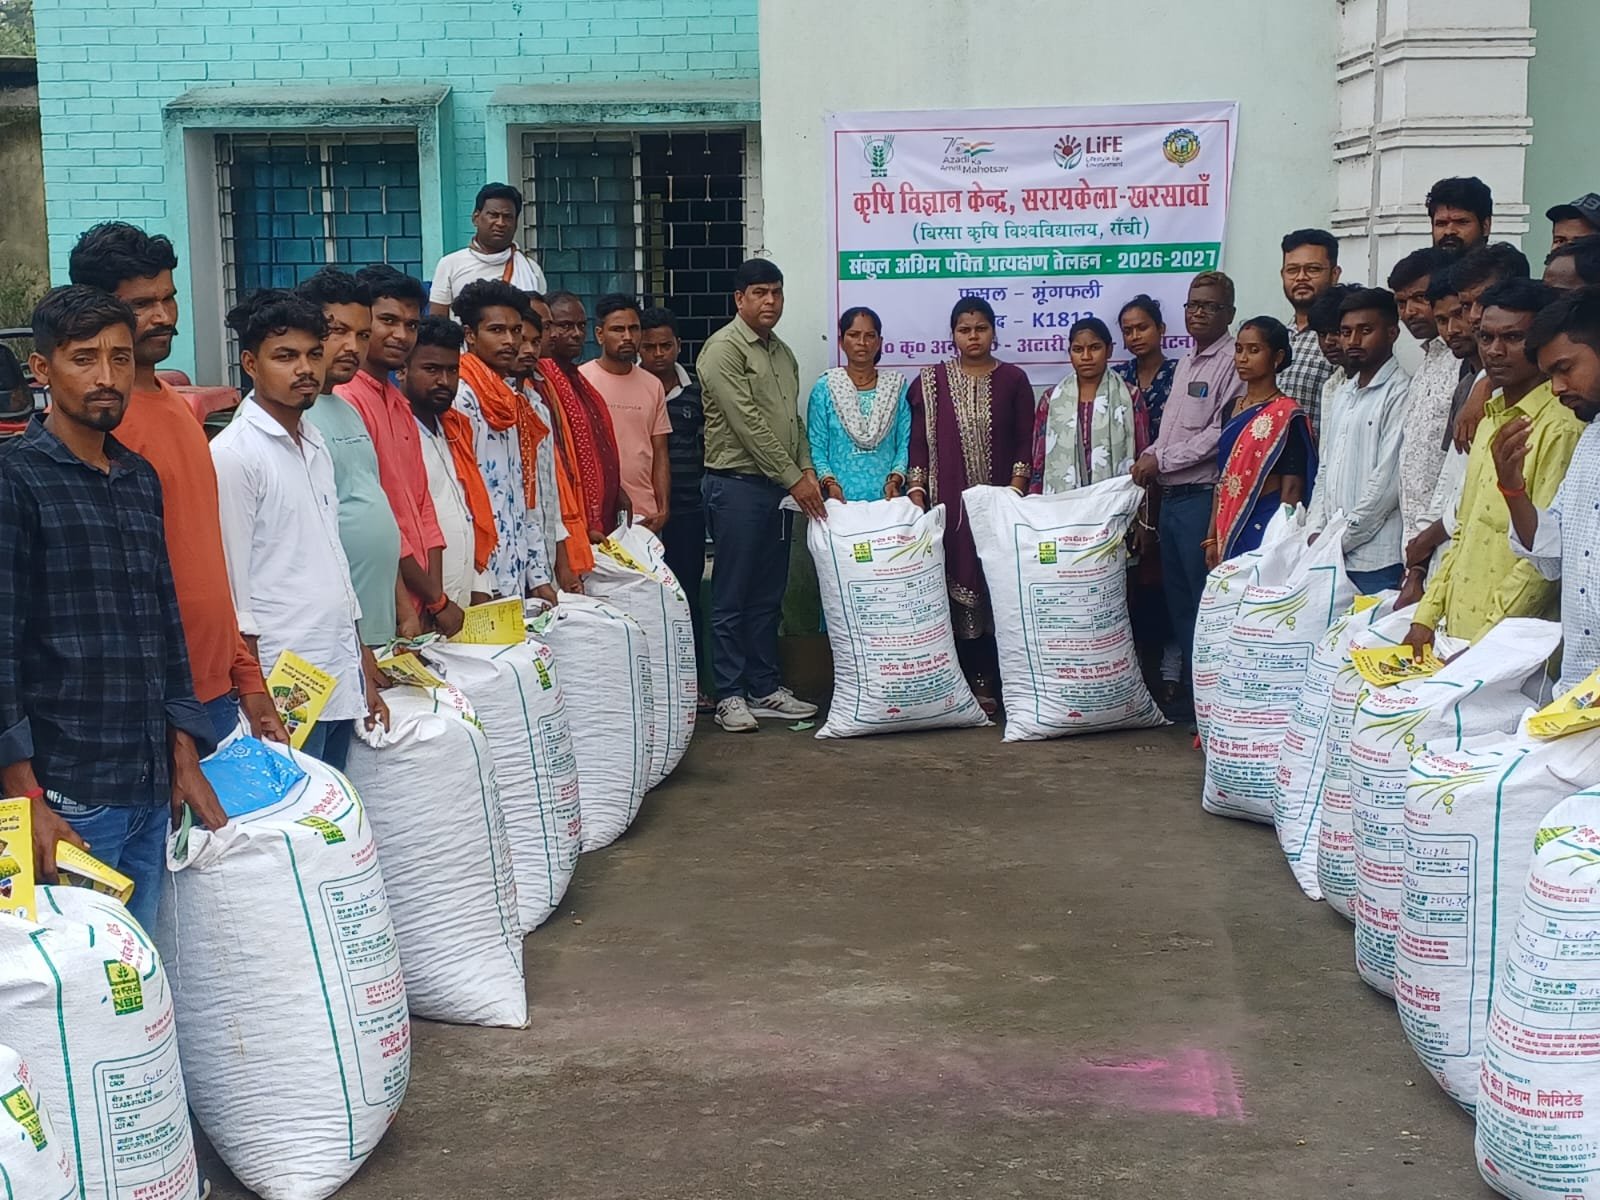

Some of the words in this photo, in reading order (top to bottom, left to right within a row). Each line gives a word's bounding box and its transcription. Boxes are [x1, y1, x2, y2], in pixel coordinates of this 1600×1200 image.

[1086, 136, 1123, 154] LiFE
[942, 156, 970, 164] Azadi
[962, 165, 1009, 174] Mahotsav
[853, 182, 895, 223] कृषि
[899, 181, 963, 216] विज्ञान
[967, 181, 1015, 215] केन्द्र,
[1022, 173, 1210, 211] सरायकेला-खरसावाँ
[967, 221, 999, 244] कृषि
[1110, 216, 1150, 239] राँची)
[849, 253, 891, 280] संकुल
[895, 253, 941, 274] अग्रिम
[944, 251, 985, 273] पंक्ति
[987, 253, 1048, 273] प्रत्यक्षण
[1052, 249, 1102, 270] तेलहन
[1118, 249, 1216, 269] 2026-2027
[1031, 279, 1103, 305] मूंगफली
[1506, 1081, 1531, 1105] निगम
[1537, 1089, 1585, 1107] लिमिटेड
[1503, 1100, 1548, 1119] CORPORATION
[1549, 1110, 1584, 1119] LIMITED
